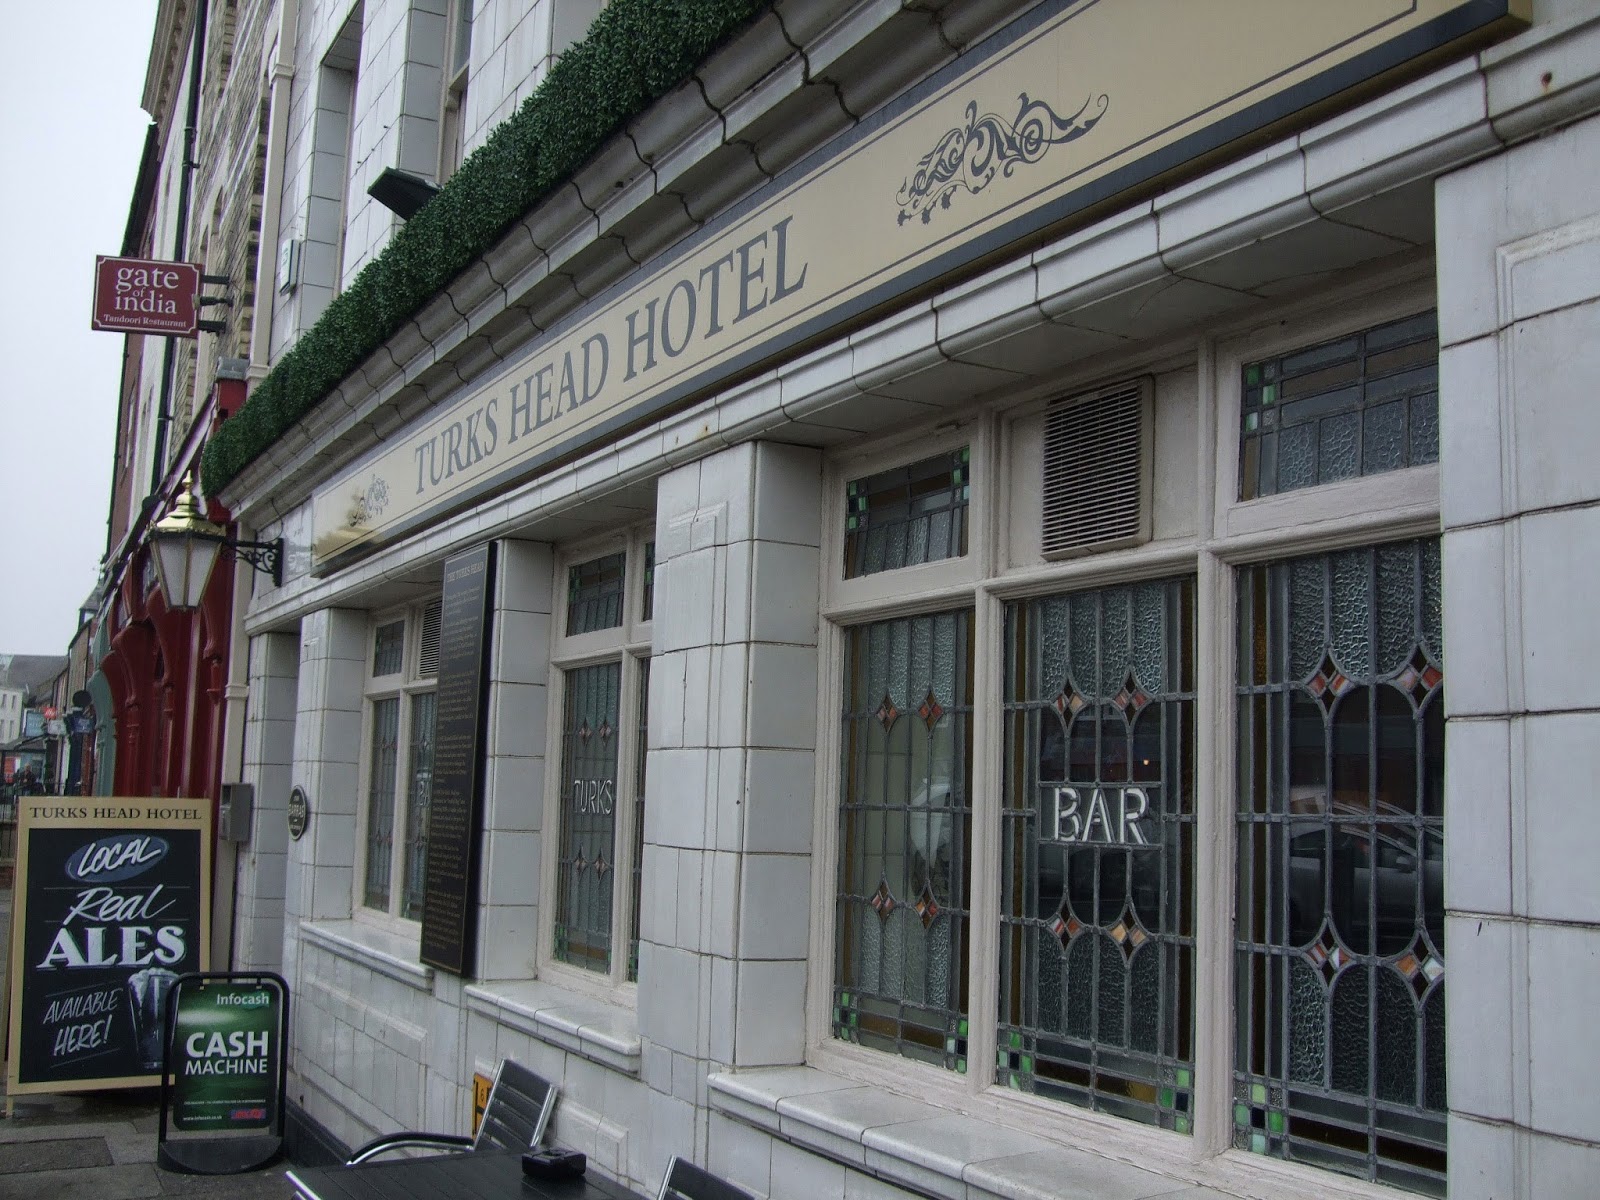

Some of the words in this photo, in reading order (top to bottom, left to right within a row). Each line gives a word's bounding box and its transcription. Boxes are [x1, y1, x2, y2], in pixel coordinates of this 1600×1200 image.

[115, 267, 179, 292] gate
[132, 287, 146, 297] of
[114, 290, 177, 314] india
[103, 314, 141, 325] Tandoori
[143, 317, 187, 328] Restaurant
[414, 397, 499, 495] TURKS
[508, 332, 609, 446] HEAD
[623, 214, 808, 383] HOTEL
[574, 779, 613, 815] TURKS
[29, 807, 88, 820] TURKS
[93, 807, 141, 820] HEAD
[146, 808, 202, 821] HOTEL
[1053, 787, 1149, 846] BAR
[77, 836, 162, 878] LOCAL
[62, 883, 177, 926] Real
[36, 925, 187, 970] ALES
[43, 987, 124, 1025] AVAILABLE
[216, 992, 270, 1006] Infocash
[53, 1013, 113, 1057] HERE!
[186, 1030, 269, 1058] CASH
[185, 1058, 268, 1075] MACHINE
